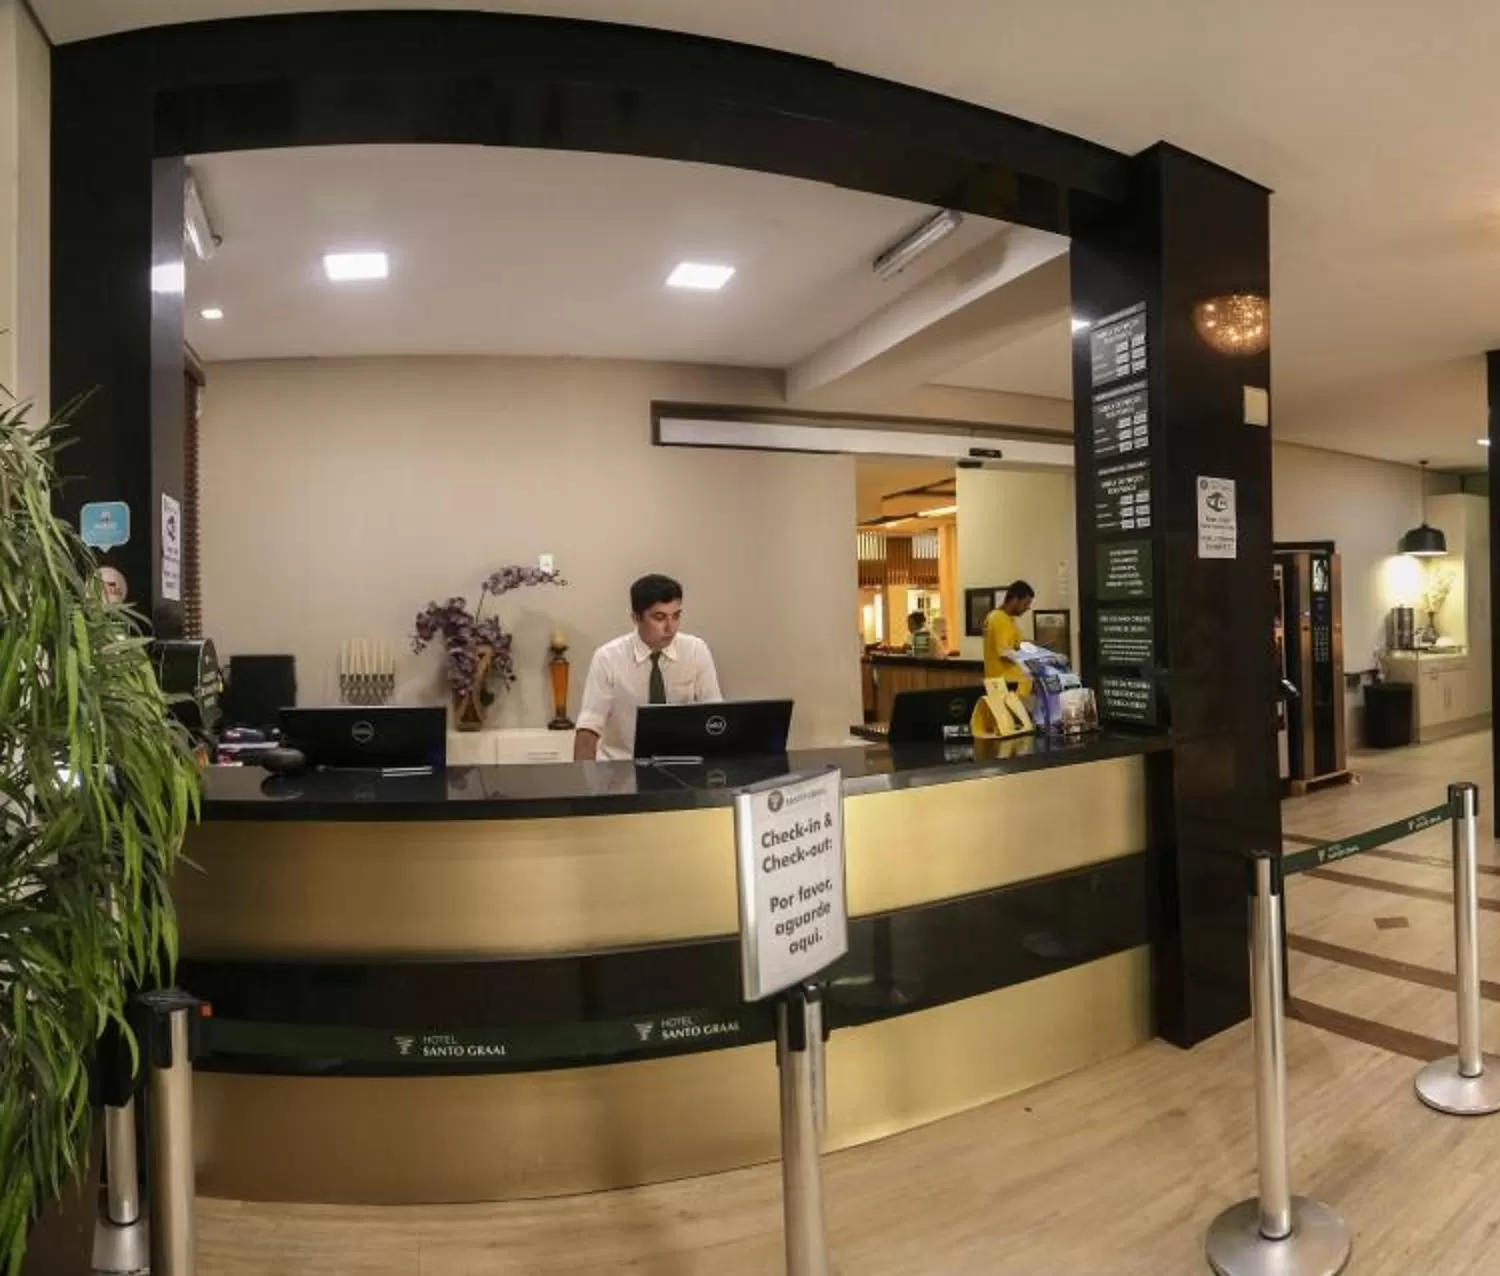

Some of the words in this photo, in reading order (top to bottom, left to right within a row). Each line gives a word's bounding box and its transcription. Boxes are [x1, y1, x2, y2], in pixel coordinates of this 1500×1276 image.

[761, 818, 821, 849] Check-in
[824, 812, 833, 828] &
[762, 838, 833, 873] Check-out:
[770, 892, 794, 913] Por
[799, 878, 833, 902] favor,
[775, 900, 831, 936] aguarde
[788, 928, 823, 954] aqui.
[661, 1016, 693, 1028] HOTEL
[662, 1027, 701, 1040] SANTO
[703, 1020, 741, 1035] GRAAL
[423, 1035, 457, 1045] HOTEL
[423, 1045, 465, 1057] SANTO
[467, 1045, 508, 1056] GRAAL
